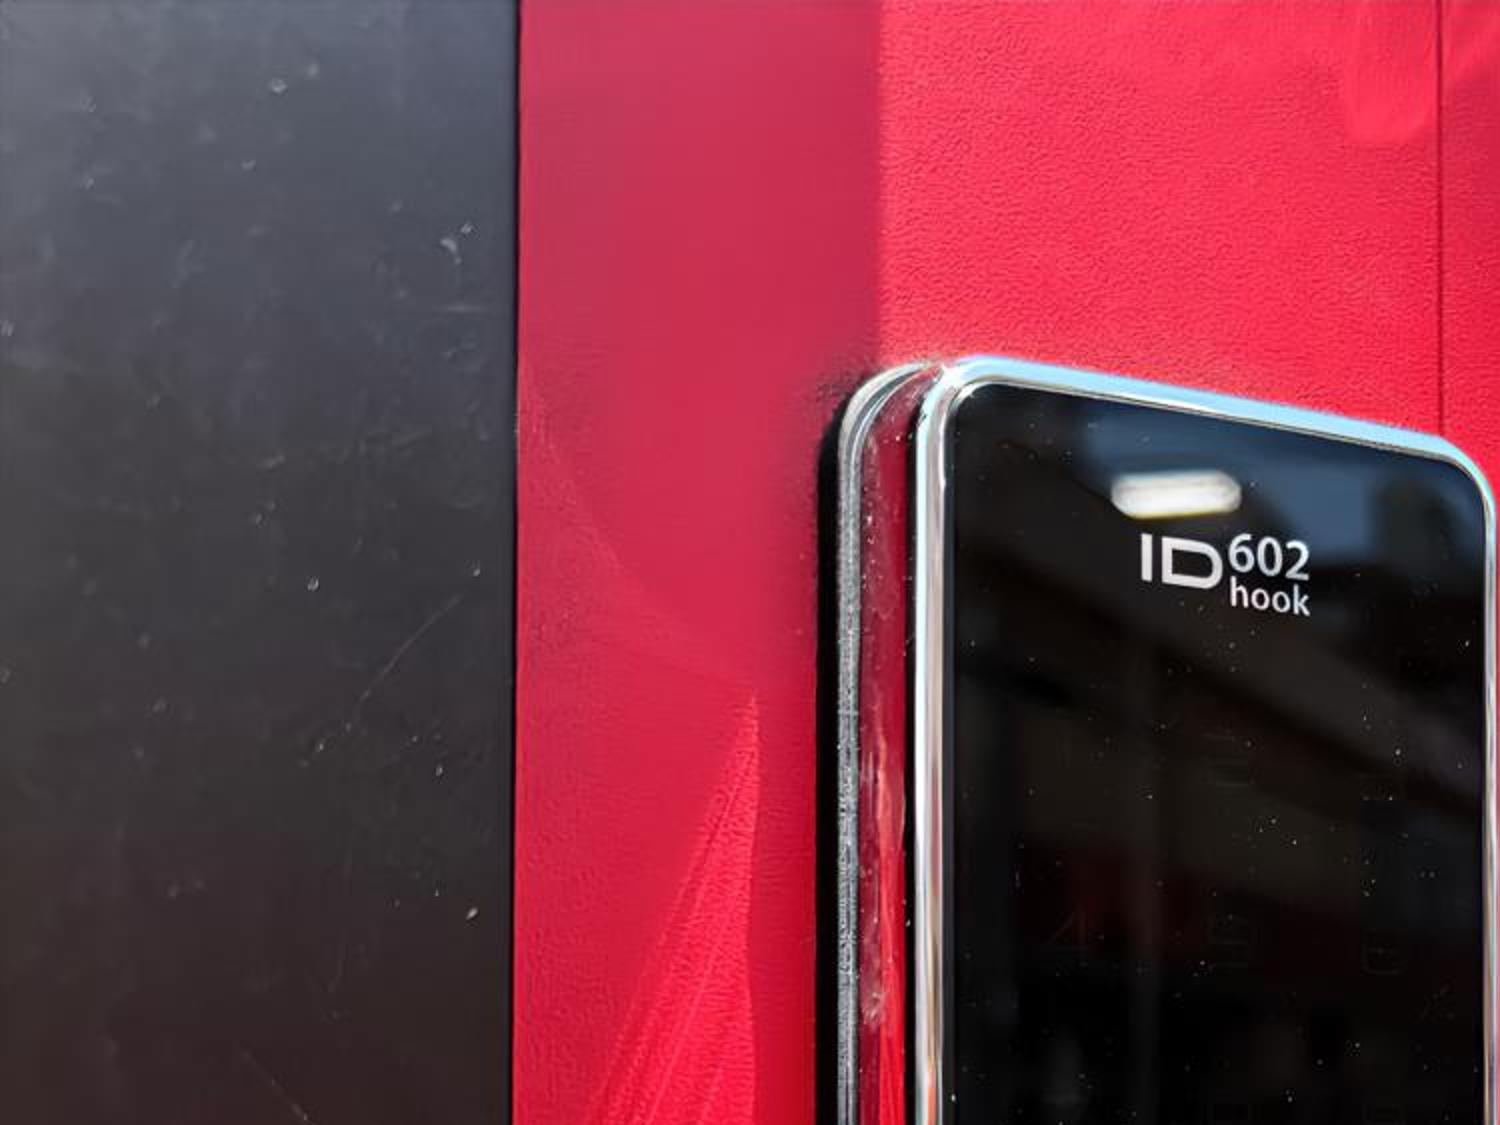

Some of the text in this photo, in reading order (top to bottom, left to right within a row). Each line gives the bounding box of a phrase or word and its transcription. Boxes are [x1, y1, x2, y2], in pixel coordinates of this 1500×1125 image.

[1140, 532, 1311, 590] ID 602
[1229, 575, 1311, 617] hook
